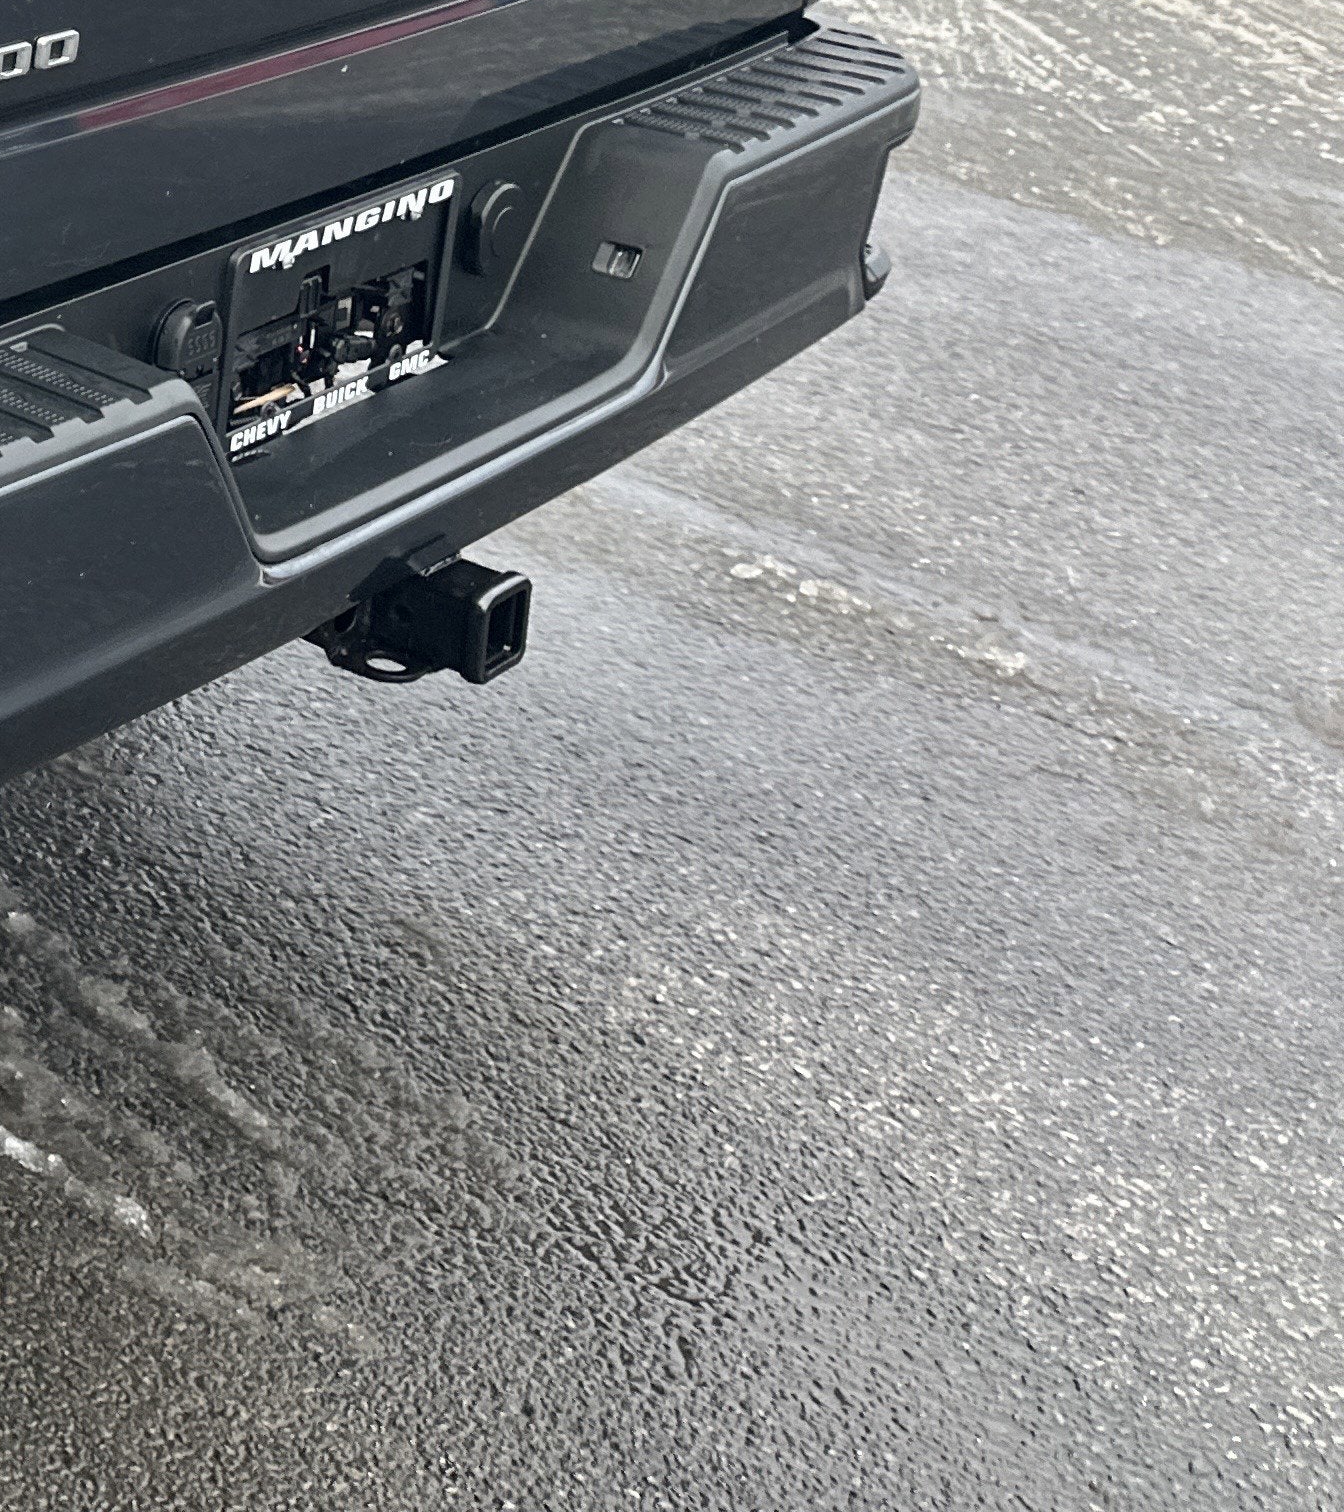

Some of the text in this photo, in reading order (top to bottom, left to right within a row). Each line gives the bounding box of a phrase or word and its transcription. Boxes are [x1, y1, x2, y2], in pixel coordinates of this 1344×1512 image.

[249, 179, 455, 274] MANGINO
[229, 349, 432, 452] CHEVY BUICK GMC
